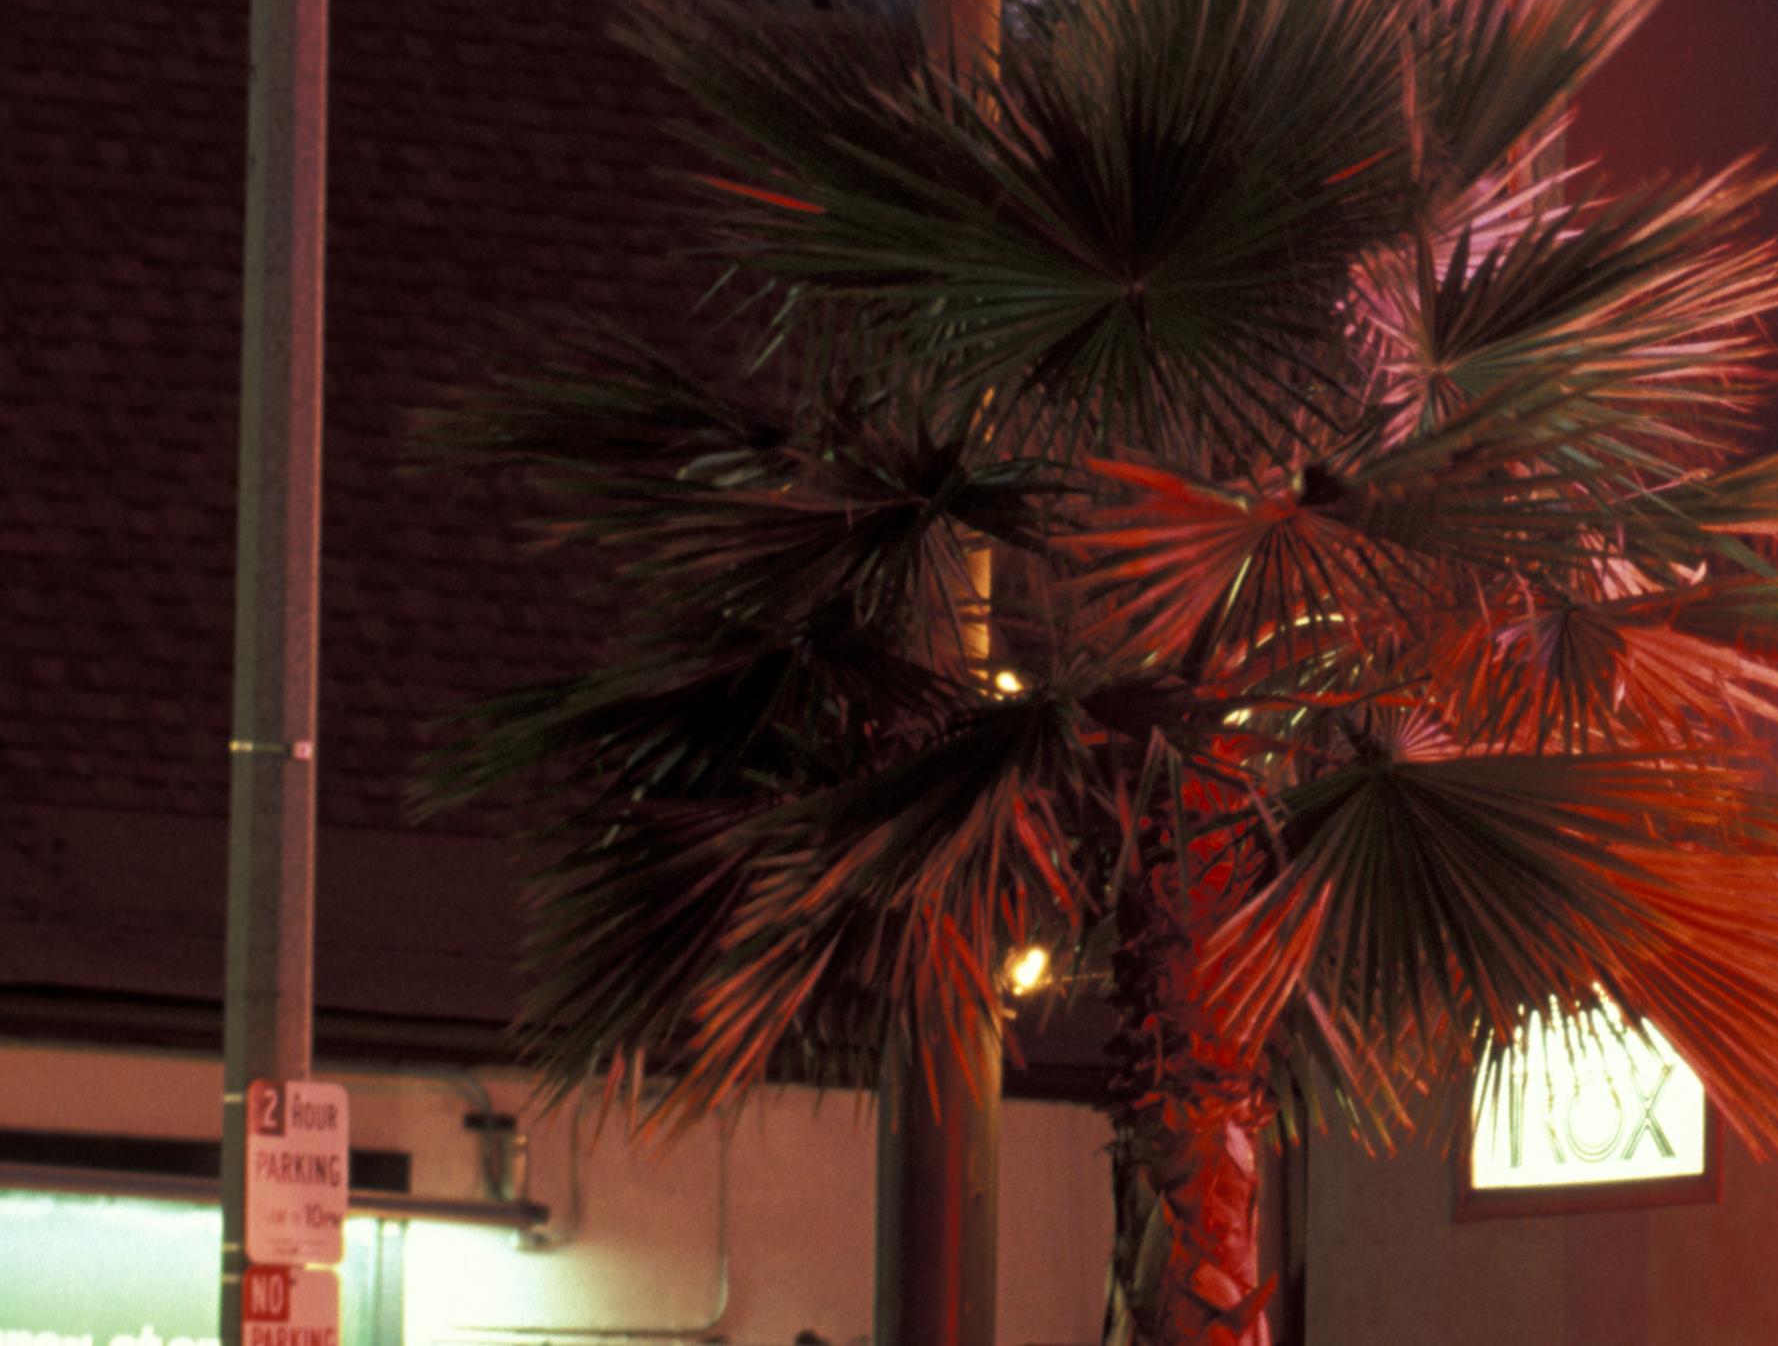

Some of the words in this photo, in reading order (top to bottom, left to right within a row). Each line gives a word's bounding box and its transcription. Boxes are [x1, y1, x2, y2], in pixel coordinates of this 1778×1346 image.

[262, 1088, 279, 1128] 2
[292, 1101, 338, 1130] HOUR
[255, 1152, 341, 1187] PARKING
[252, 1274, 284, 1314] NO
